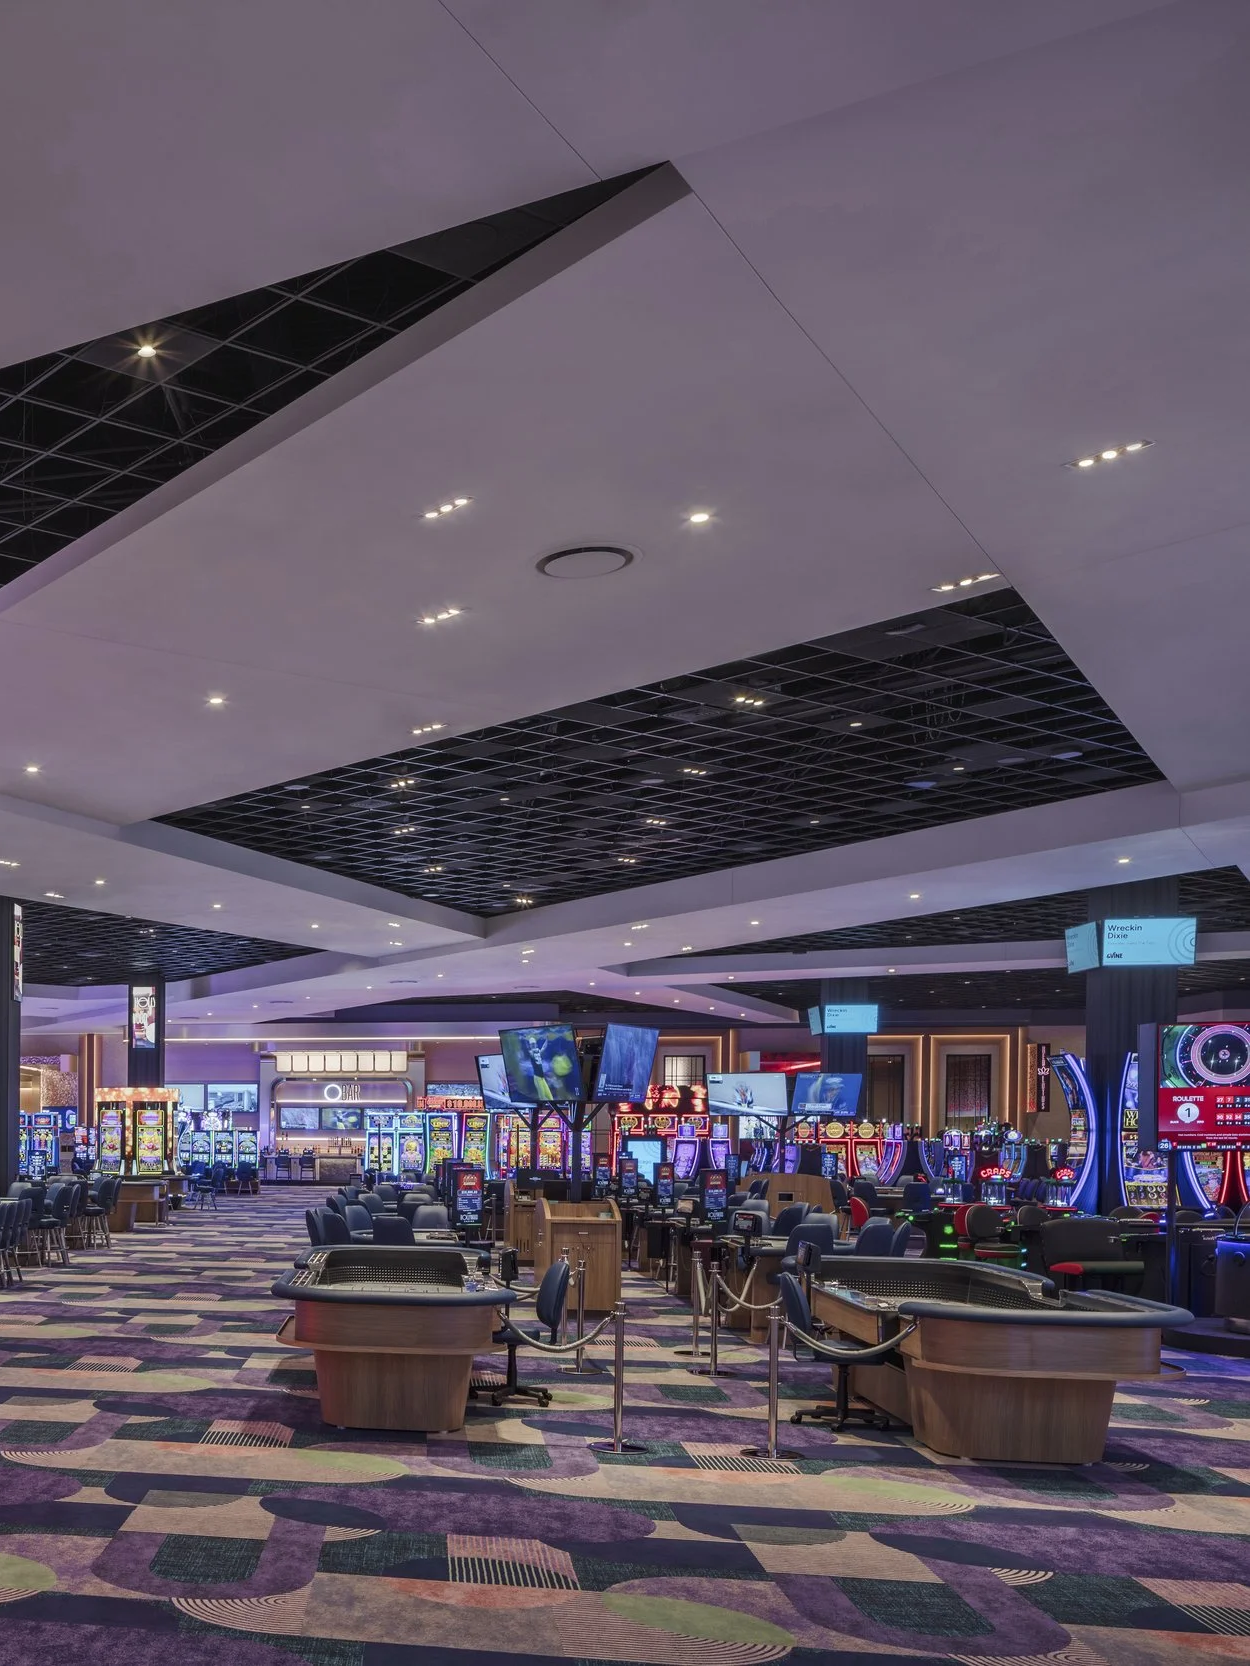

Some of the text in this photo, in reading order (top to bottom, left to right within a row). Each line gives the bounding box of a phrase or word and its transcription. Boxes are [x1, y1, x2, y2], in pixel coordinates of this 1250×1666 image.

[1185, 1108, 1191, 1118] 1
[980, 1167, 1012, 1178] CRAPS
[1056, 1168, 1074, 1179] CRAPS
